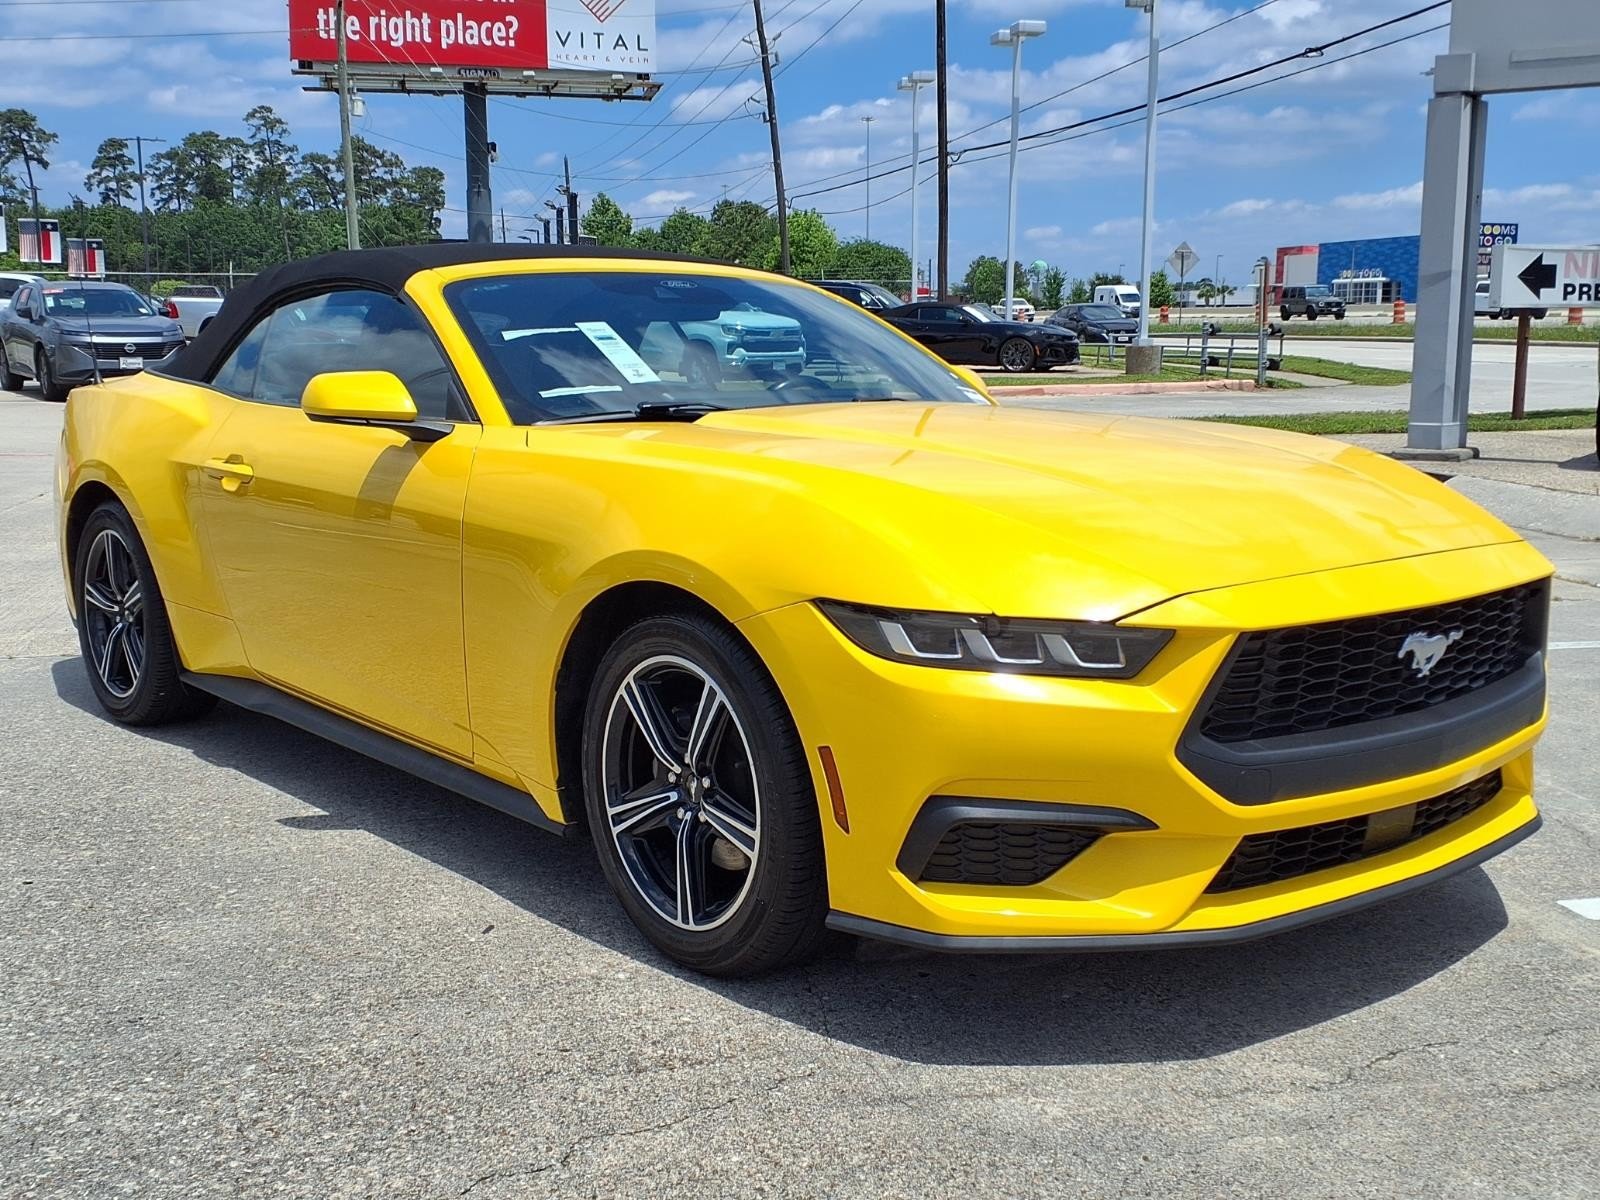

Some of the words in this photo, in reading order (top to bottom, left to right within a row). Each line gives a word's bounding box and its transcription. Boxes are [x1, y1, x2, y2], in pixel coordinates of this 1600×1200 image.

[316, 7, 360, 40] the
[369, 9, 432, 47] right
[440, 12, 519, 49] place?
[555, 30, 649, 52] VITAL
[556, 54, 597, 62] HEART
[1480, 236, 1493, 246] TO
[1495, 236, 1513, 245] GO
[1564, 251, 1600, 279] NI
[1562, 283, 1600, 301] PRE
